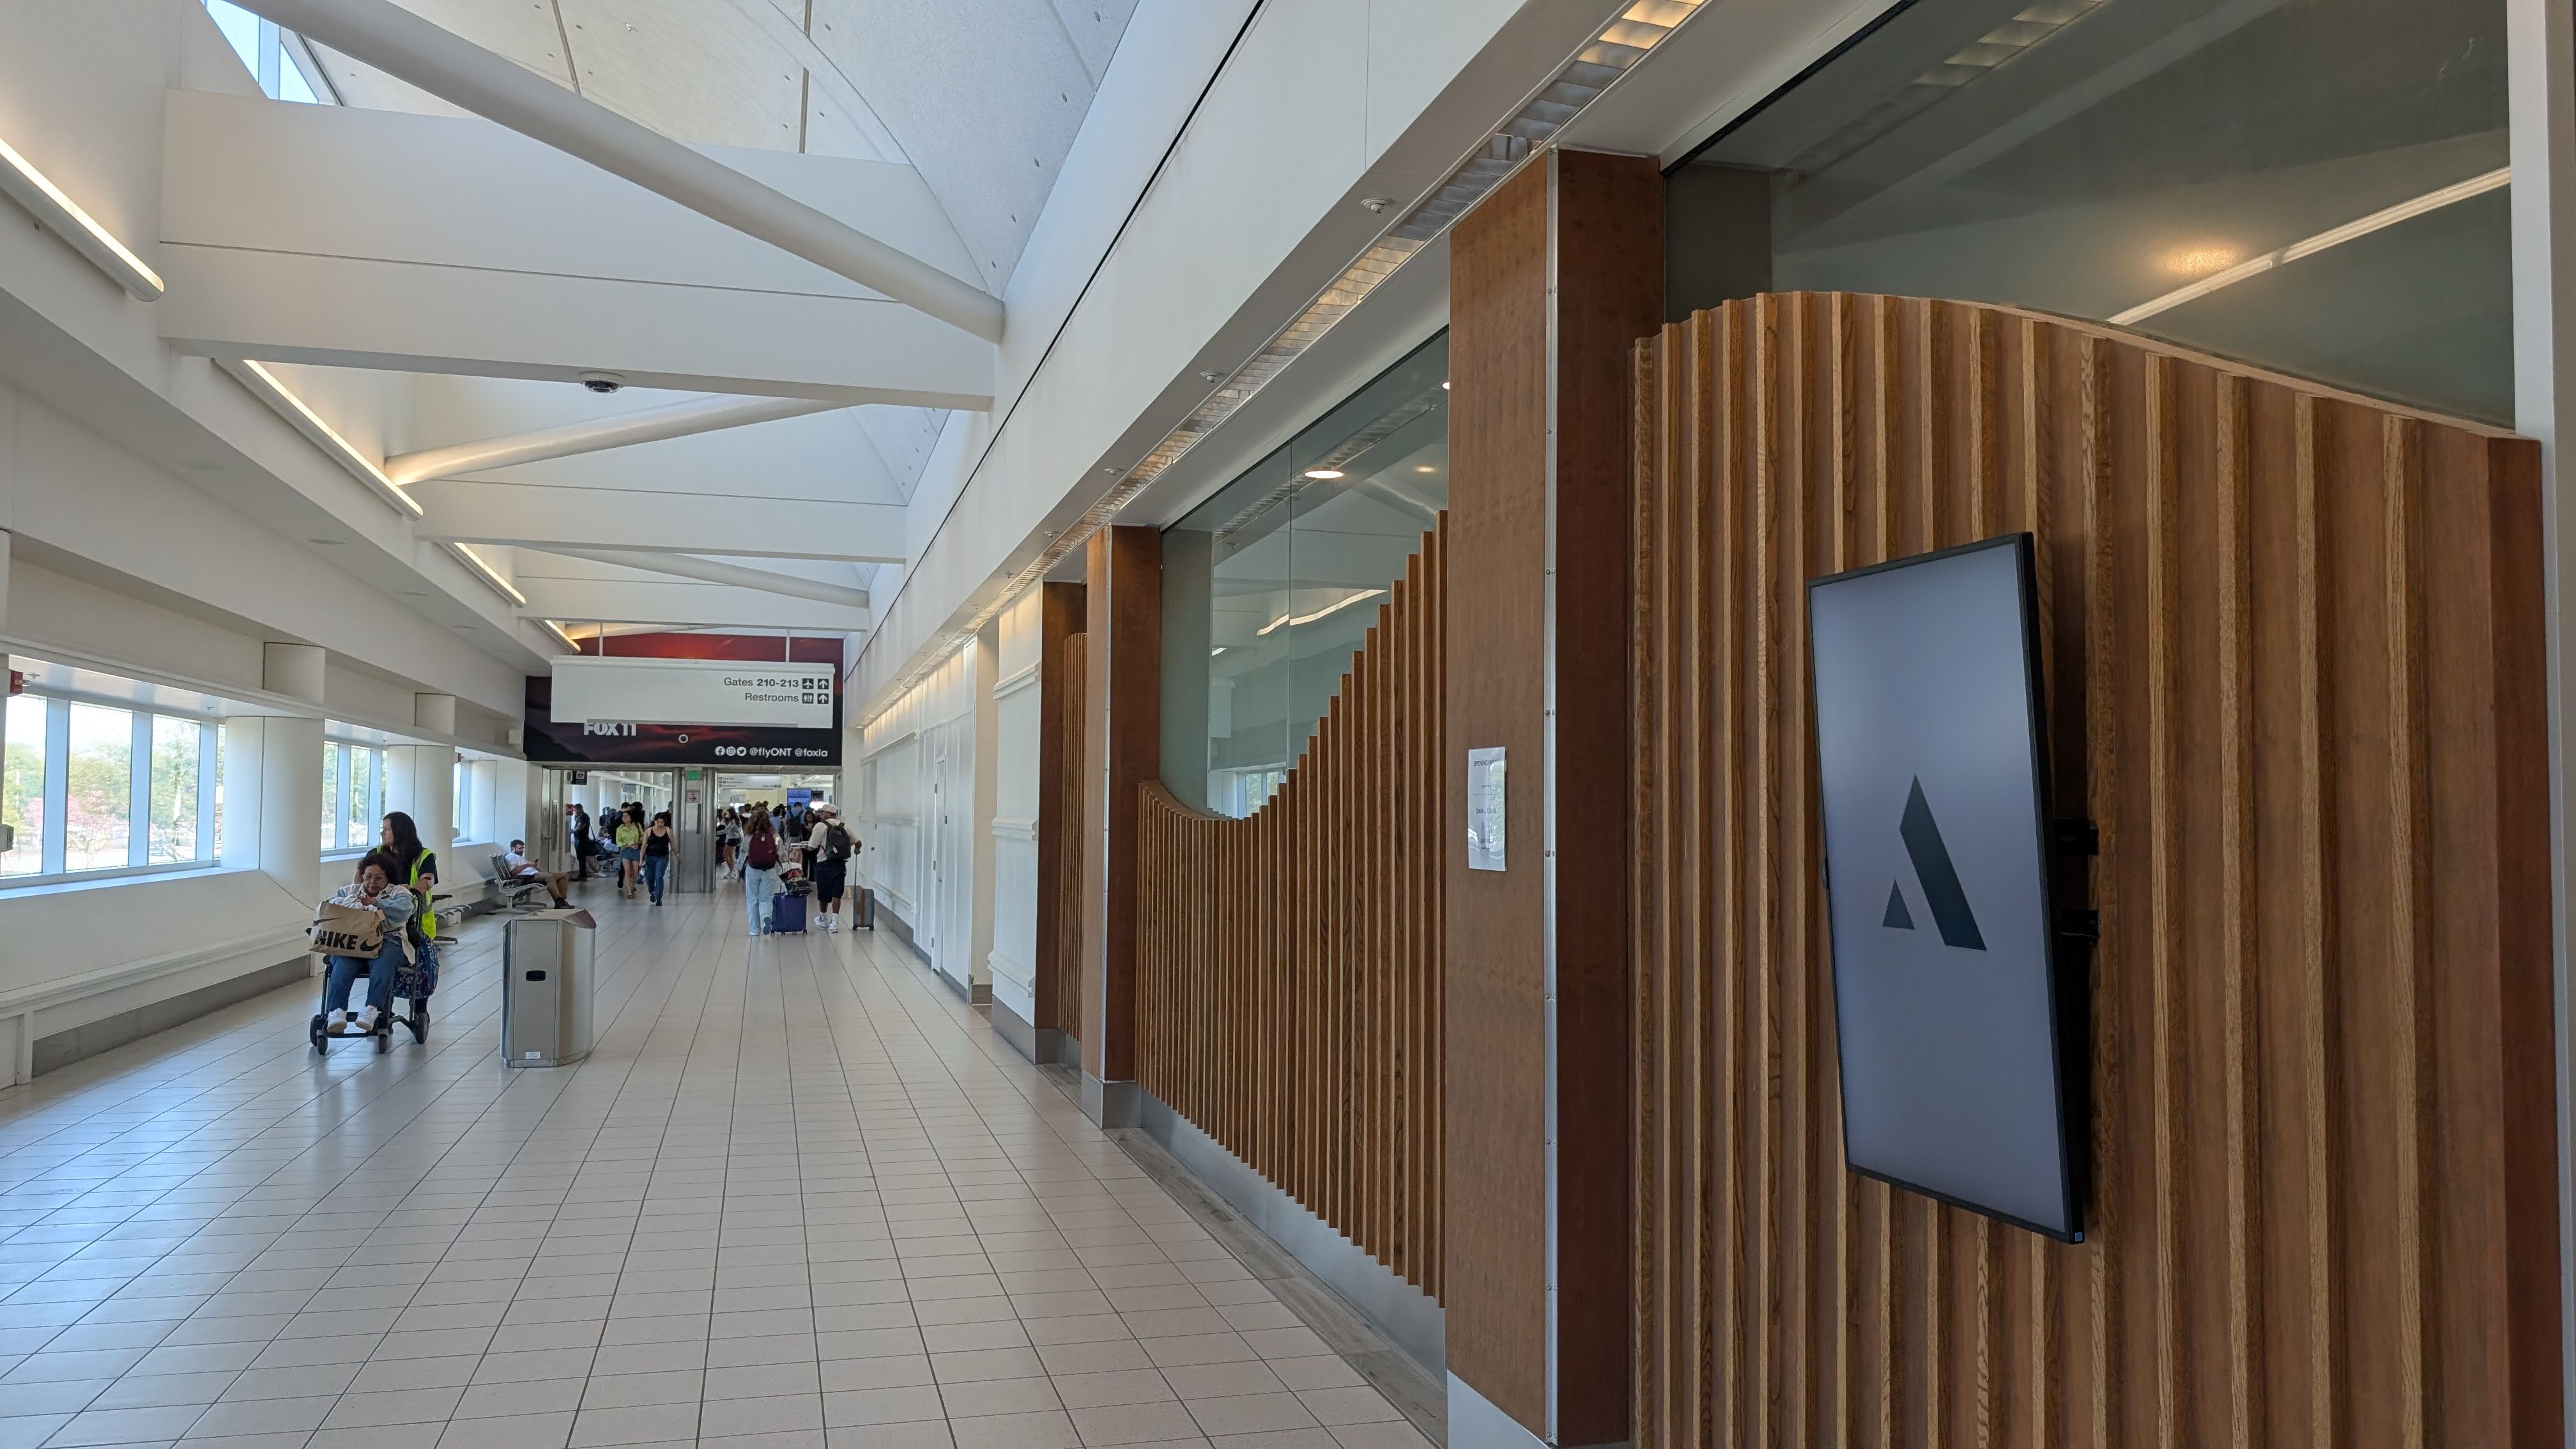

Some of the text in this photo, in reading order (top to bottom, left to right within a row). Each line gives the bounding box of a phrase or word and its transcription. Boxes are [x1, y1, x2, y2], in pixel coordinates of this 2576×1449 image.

[724, 677, 799, 687] Gates 210-213
[745, 693, 799, 702] Restrooms
[583, 723, 636, 737] FOX 11
[749, 747, 828, 758] @flyONT @foxla
[314, 929, 358, 950] NIKE
